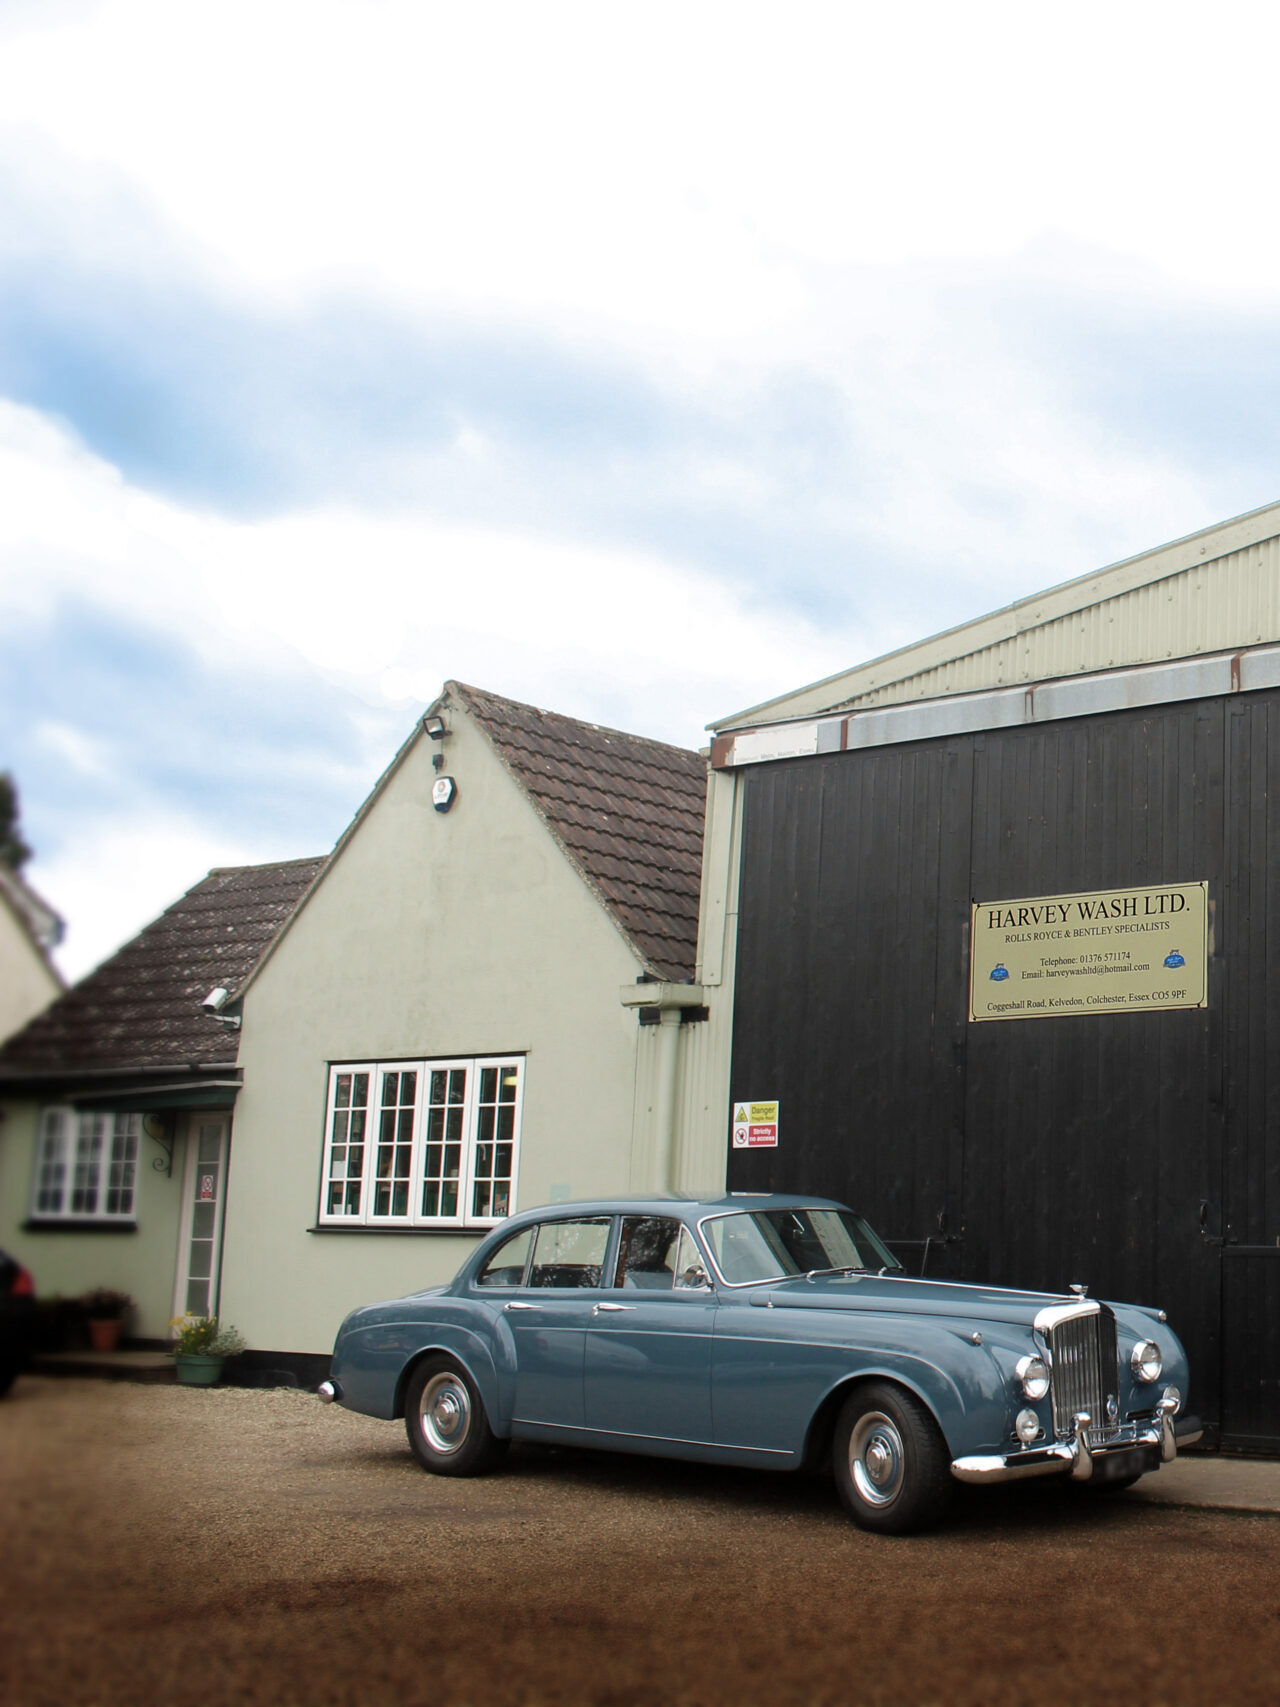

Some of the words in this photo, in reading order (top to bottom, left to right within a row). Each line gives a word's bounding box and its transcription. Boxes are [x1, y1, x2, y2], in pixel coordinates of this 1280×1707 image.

[988, 903, 1072, 929] HARVEY
[1077, 897, 1138, 920] WASH
[1144, 893, 1190, 915] LTD.
[1005, 933, 1031, 943] ROLLS
[1033, 930, 1062, 940] ROYCE
[1064, 929, 1071, 938] &
[1073, 926, 1113, 937] BENTLEY
[1114, 921, 1170, 934] SPECIALISTS
[1040, 956, 1078, 967] Telephone:
[1079, 953, 1102, 964] 01376
[1104, 951, 1131, 962] 571174
[1021, 970, 1044, 979] Email:
[1046, 963, 1150, 978] harveywashltd@hotmail.com
[987, 1000, 1025, 1012] Coggeshall
[1026, 999, 1047, 1009] Road,
[1048, 997, 1084, 1007] Kelvedon,
[1086, 994, 1127, 1004] Colchester,
[1128, 993, 1150, 1002] Essex
[1151, 990, 1169, 1000] CO5
[1171, 989, 1187, 999] 9PF
[751, 1106, 775, 1116] Danger
